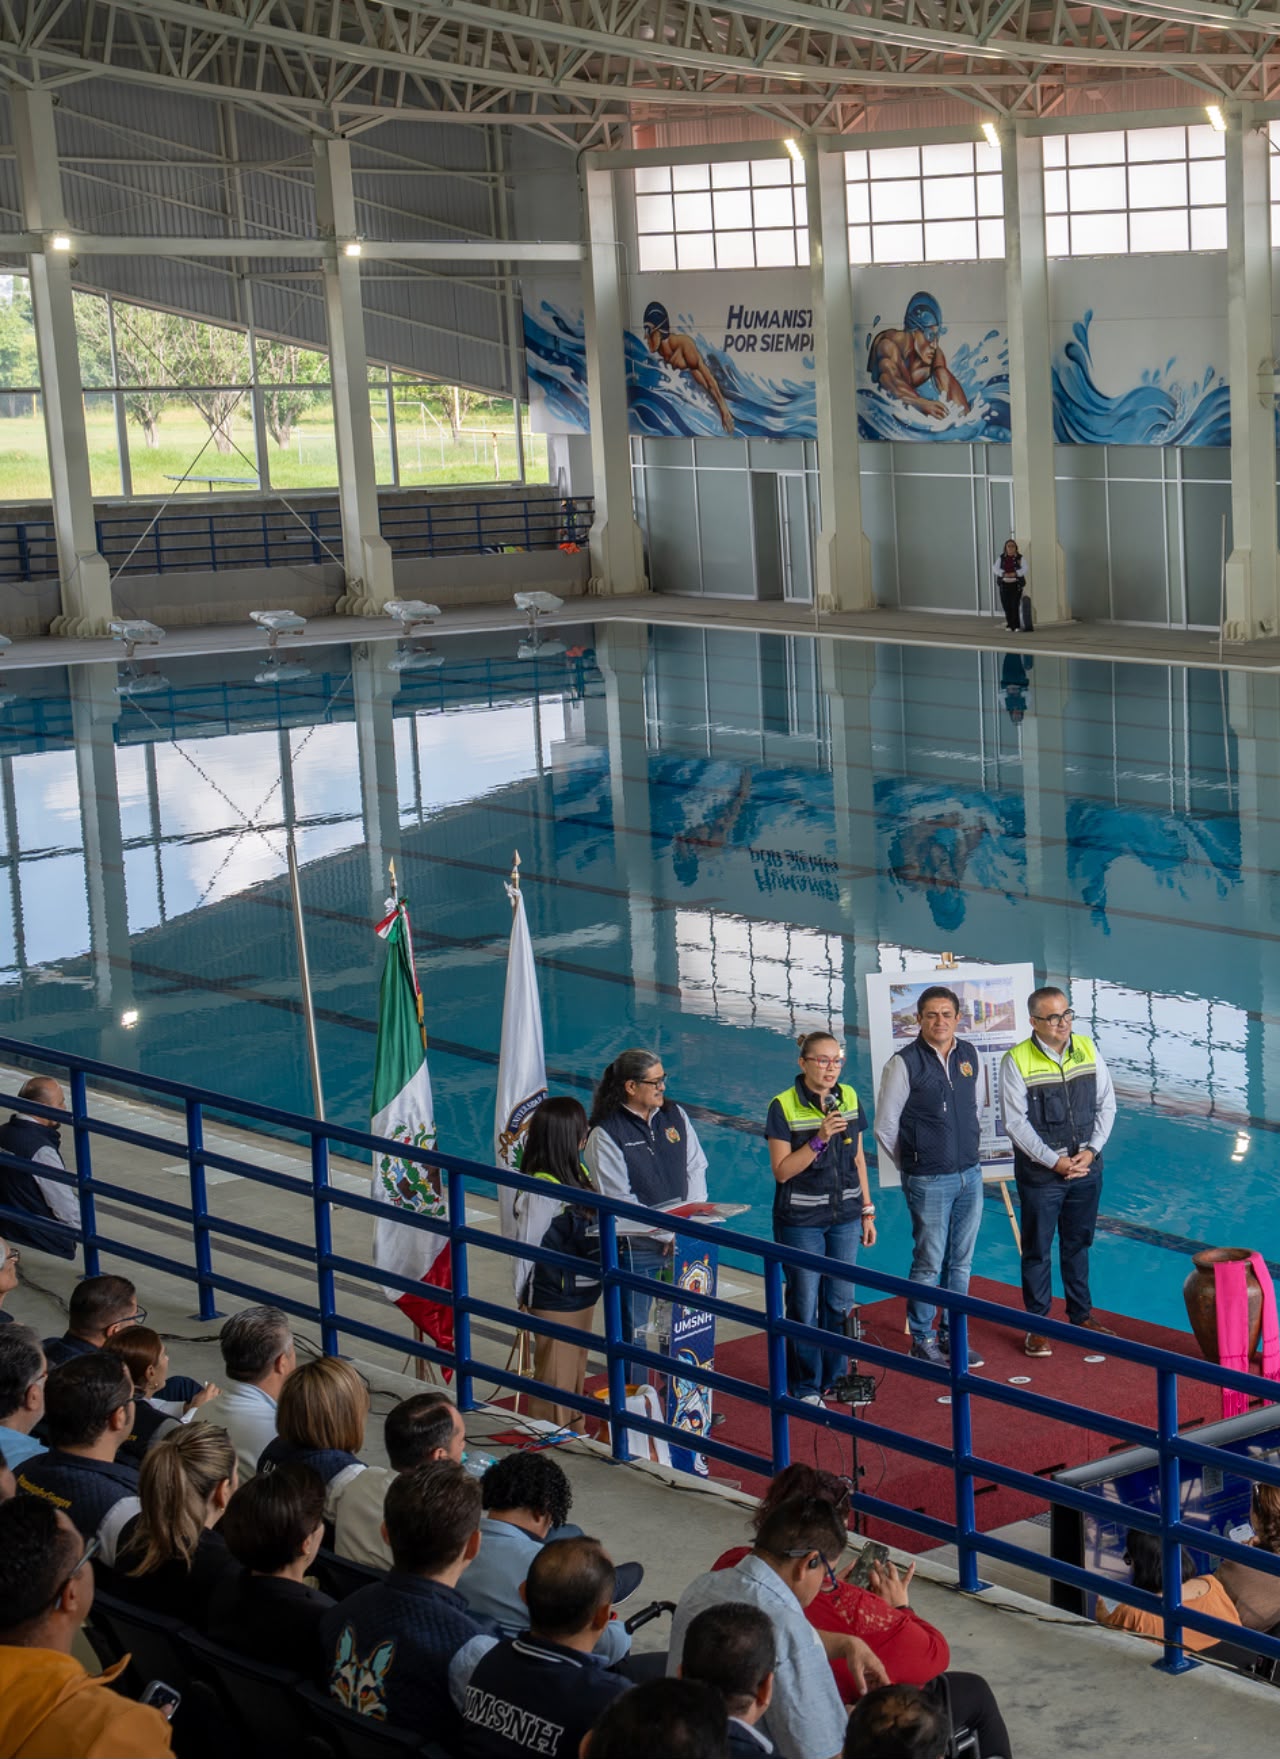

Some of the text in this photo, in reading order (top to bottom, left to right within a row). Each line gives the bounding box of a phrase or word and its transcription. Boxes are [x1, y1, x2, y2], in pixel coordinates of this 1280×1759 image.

[726, 305, 813, 329] HUMANIST
[723, 333, 815, 353] POR SIEMP
[674, 1312, 712, 1334] UMSNH
